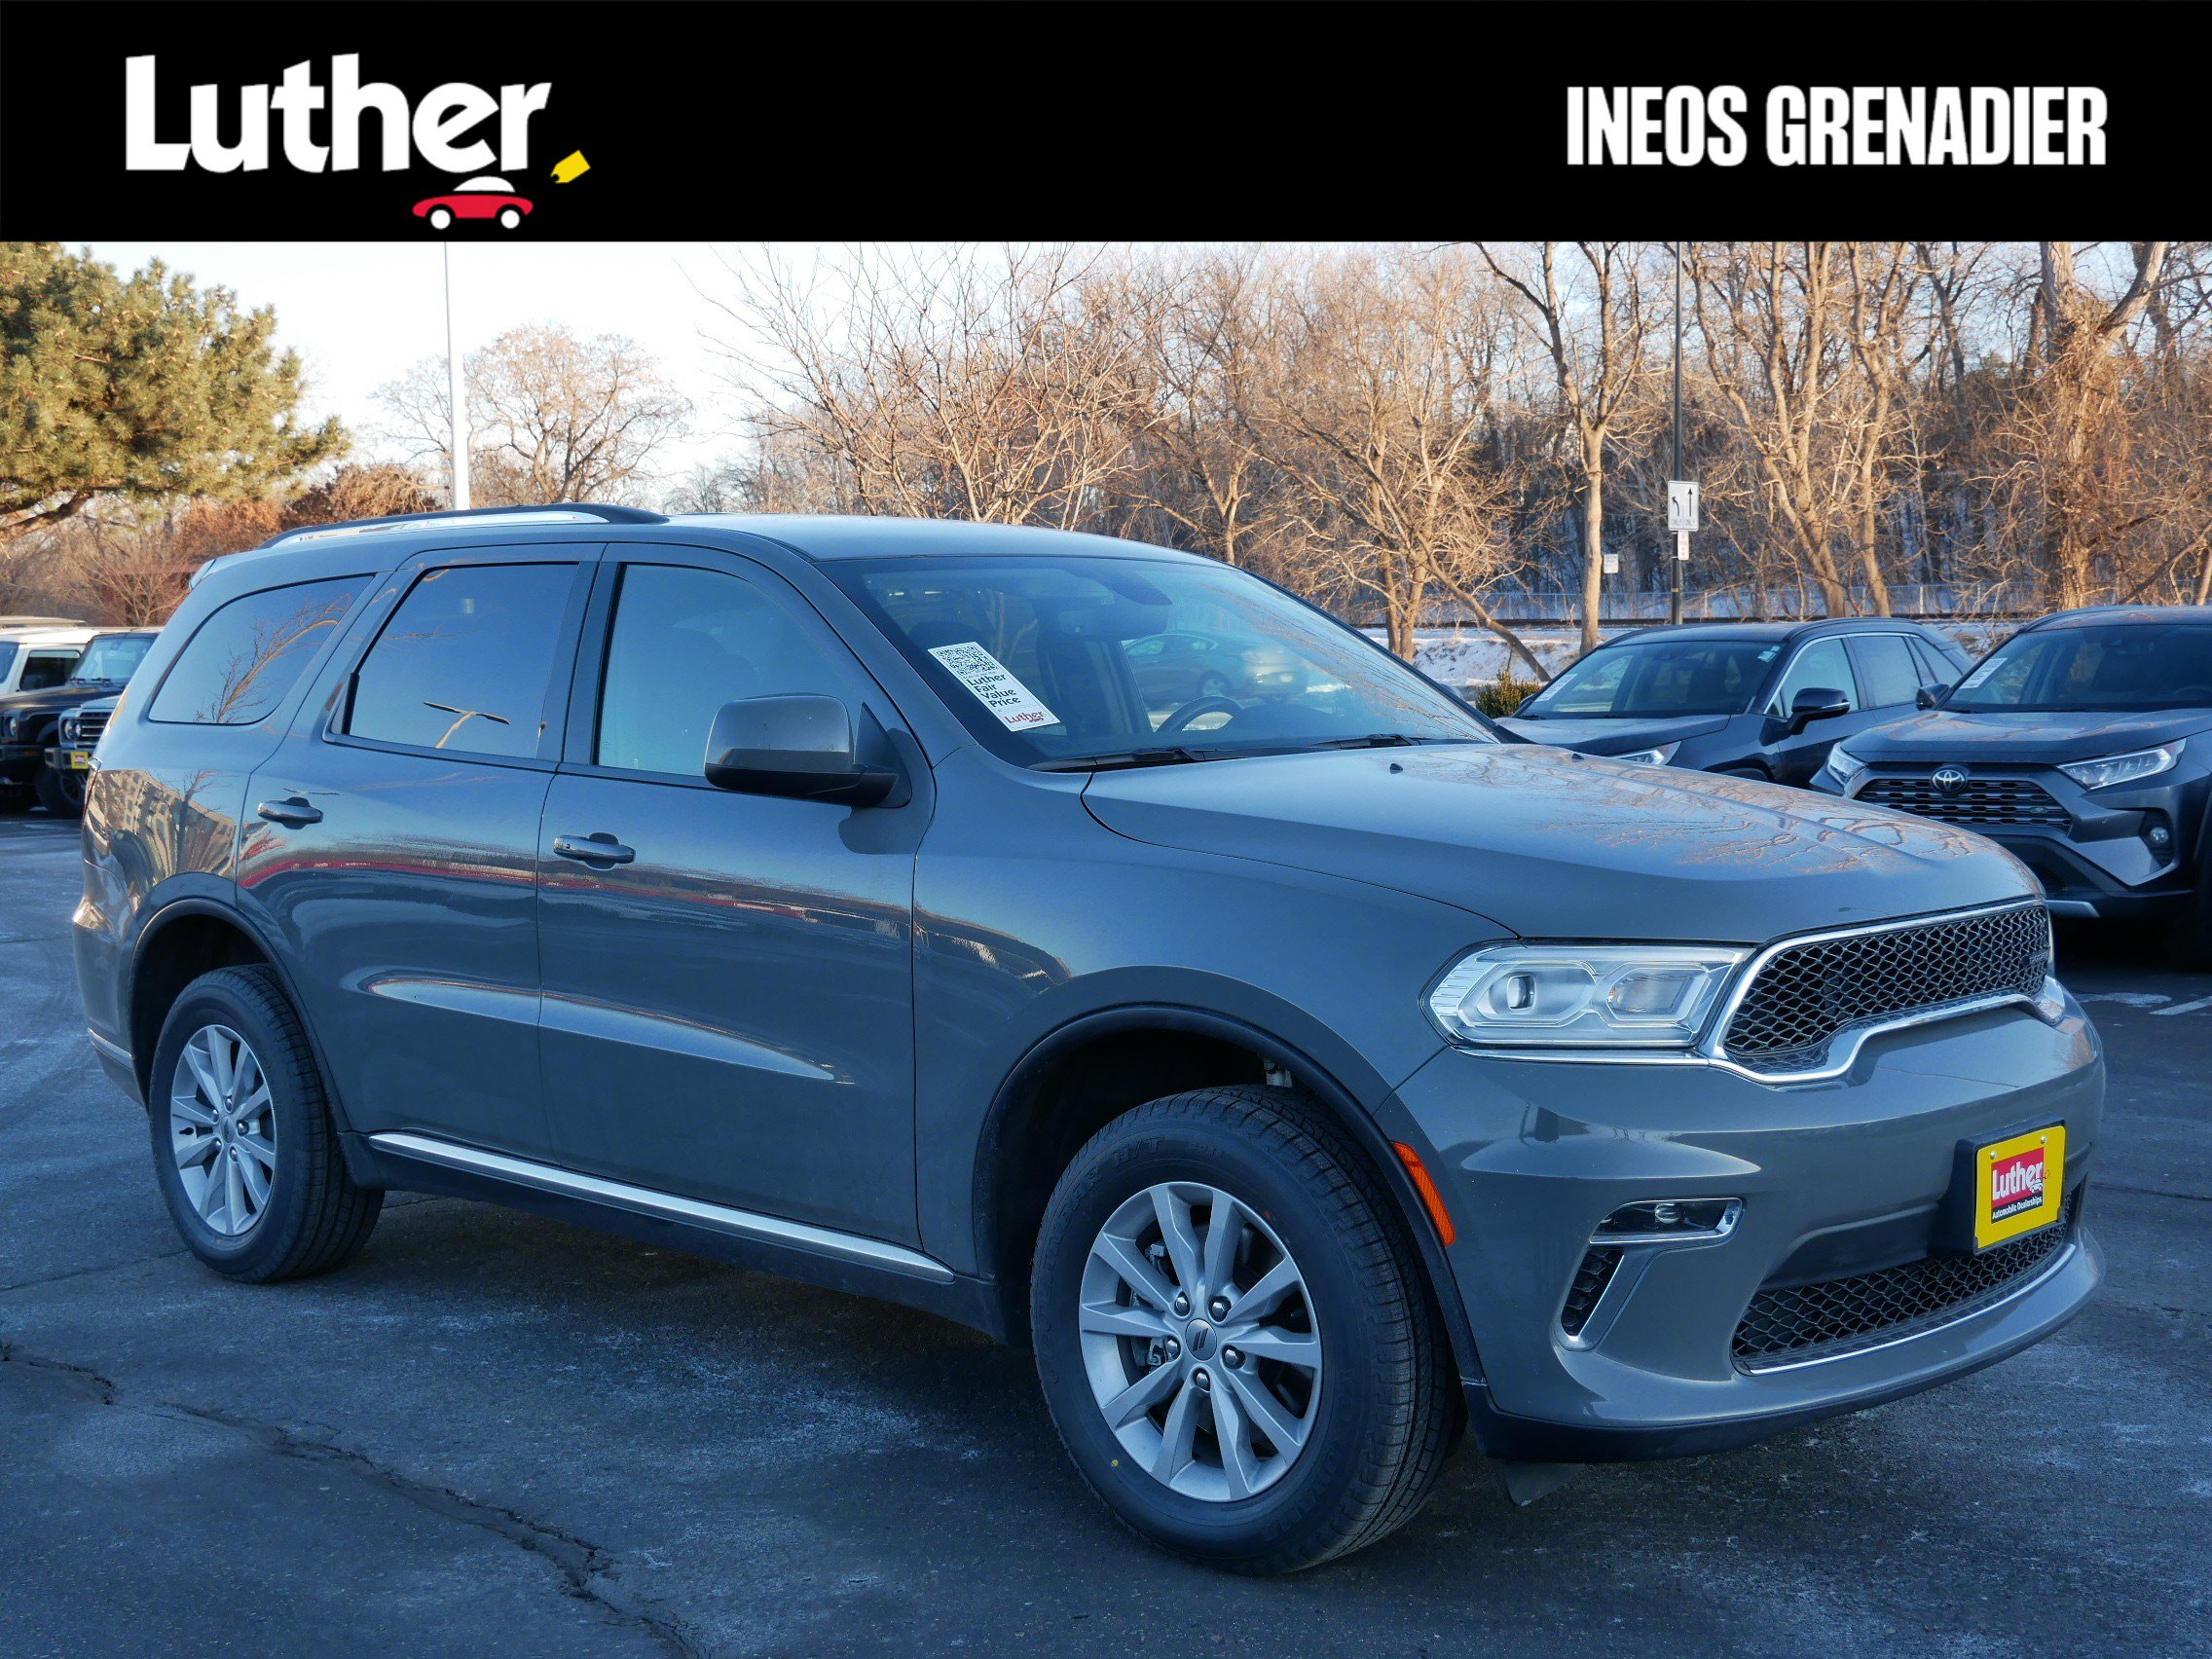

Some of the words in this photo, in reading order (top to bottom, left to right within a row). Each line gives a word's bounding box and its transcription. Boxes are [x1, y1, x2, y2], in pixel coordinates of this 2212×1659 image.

[966, 674, 1006, 685] Luther
[974, 683, 997, 692] Fair
[980, 689, 1016, 699] Value
[988, 697, 1021, 708] Price
[1004, 712, 1044, 723] Luther
[1992, 1161, 2044, 1200] Luther
[1992, 1203, 2017, 1220] Automobile
[2016, 1196, 2043, 1211] Dealerships
